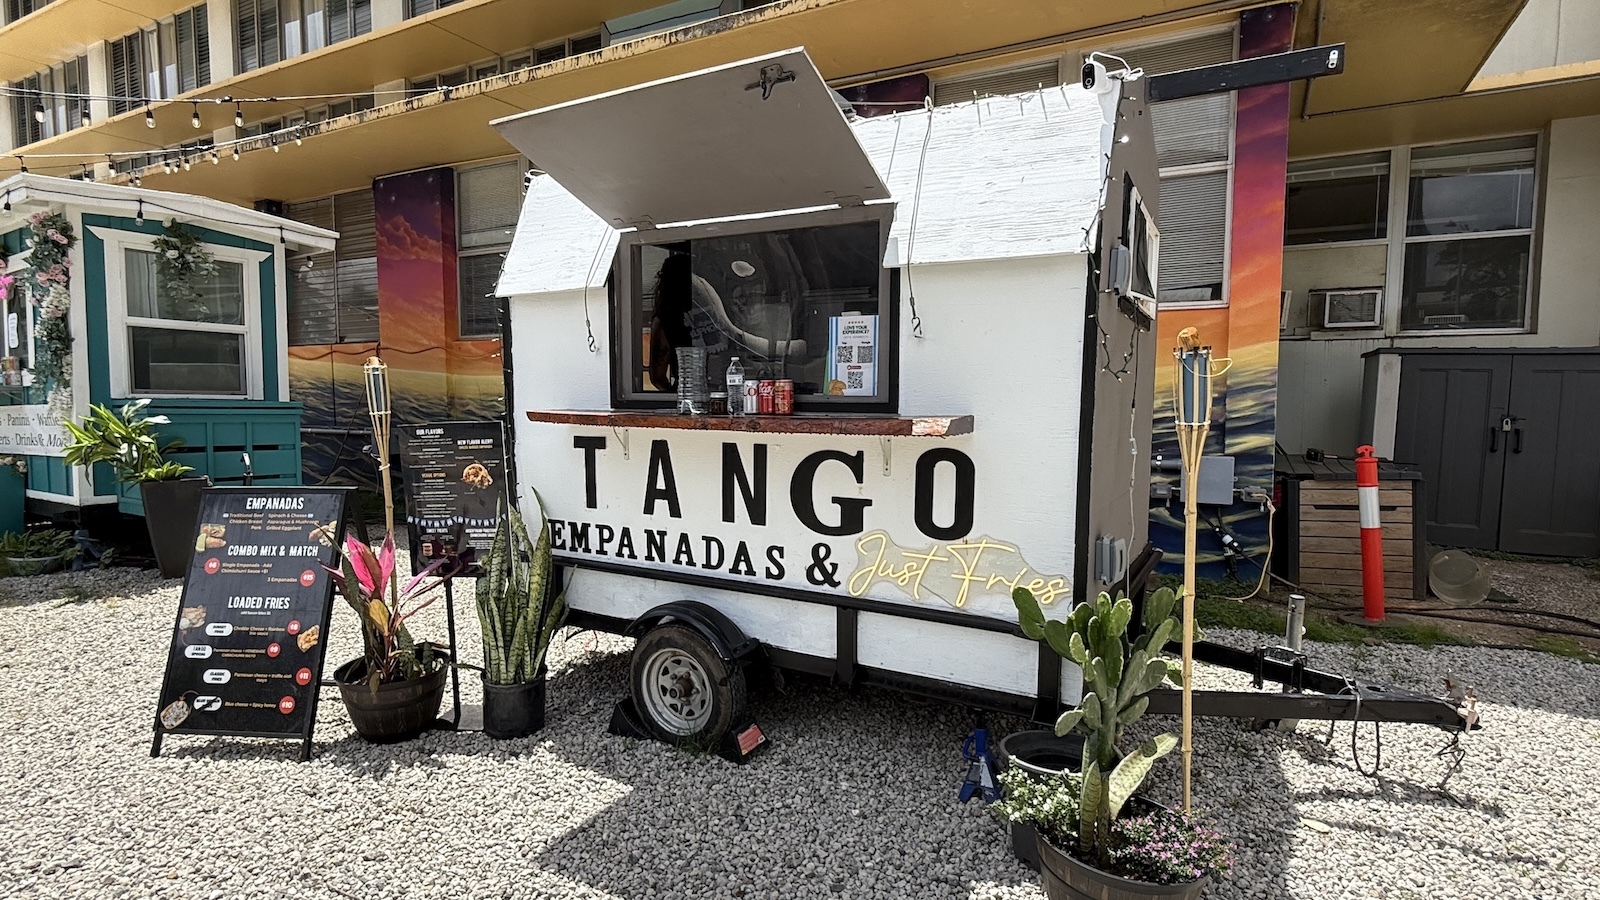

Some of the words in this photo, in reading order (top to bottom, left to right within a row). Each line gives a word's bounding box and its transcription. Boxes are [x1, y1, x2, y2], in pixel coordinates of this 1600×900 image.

[7, 413, 30, 426] Paninis
[37, 412, 62, 427] Waffle
[15, 433, 38, 446] Drinks
[573, 436, 977, 541] TANGO
[246, 497, 305, 509] EMPANADAS
[227, 545, 258, 556] COMBO
[260, 545, 278, 556] MIX
[278, 545, 286, 556] &
[289, 545, 319, 557] MATCH
[549, 518, 786, 580] EMPANADAS
[805, 542, 842, 588] &
[849, 534, 949, 597] Just
[946, 539, 1070, 608] Fries
[228, 596, 263, 609] LOADED
[264, 597, 290, 609] FRIES
